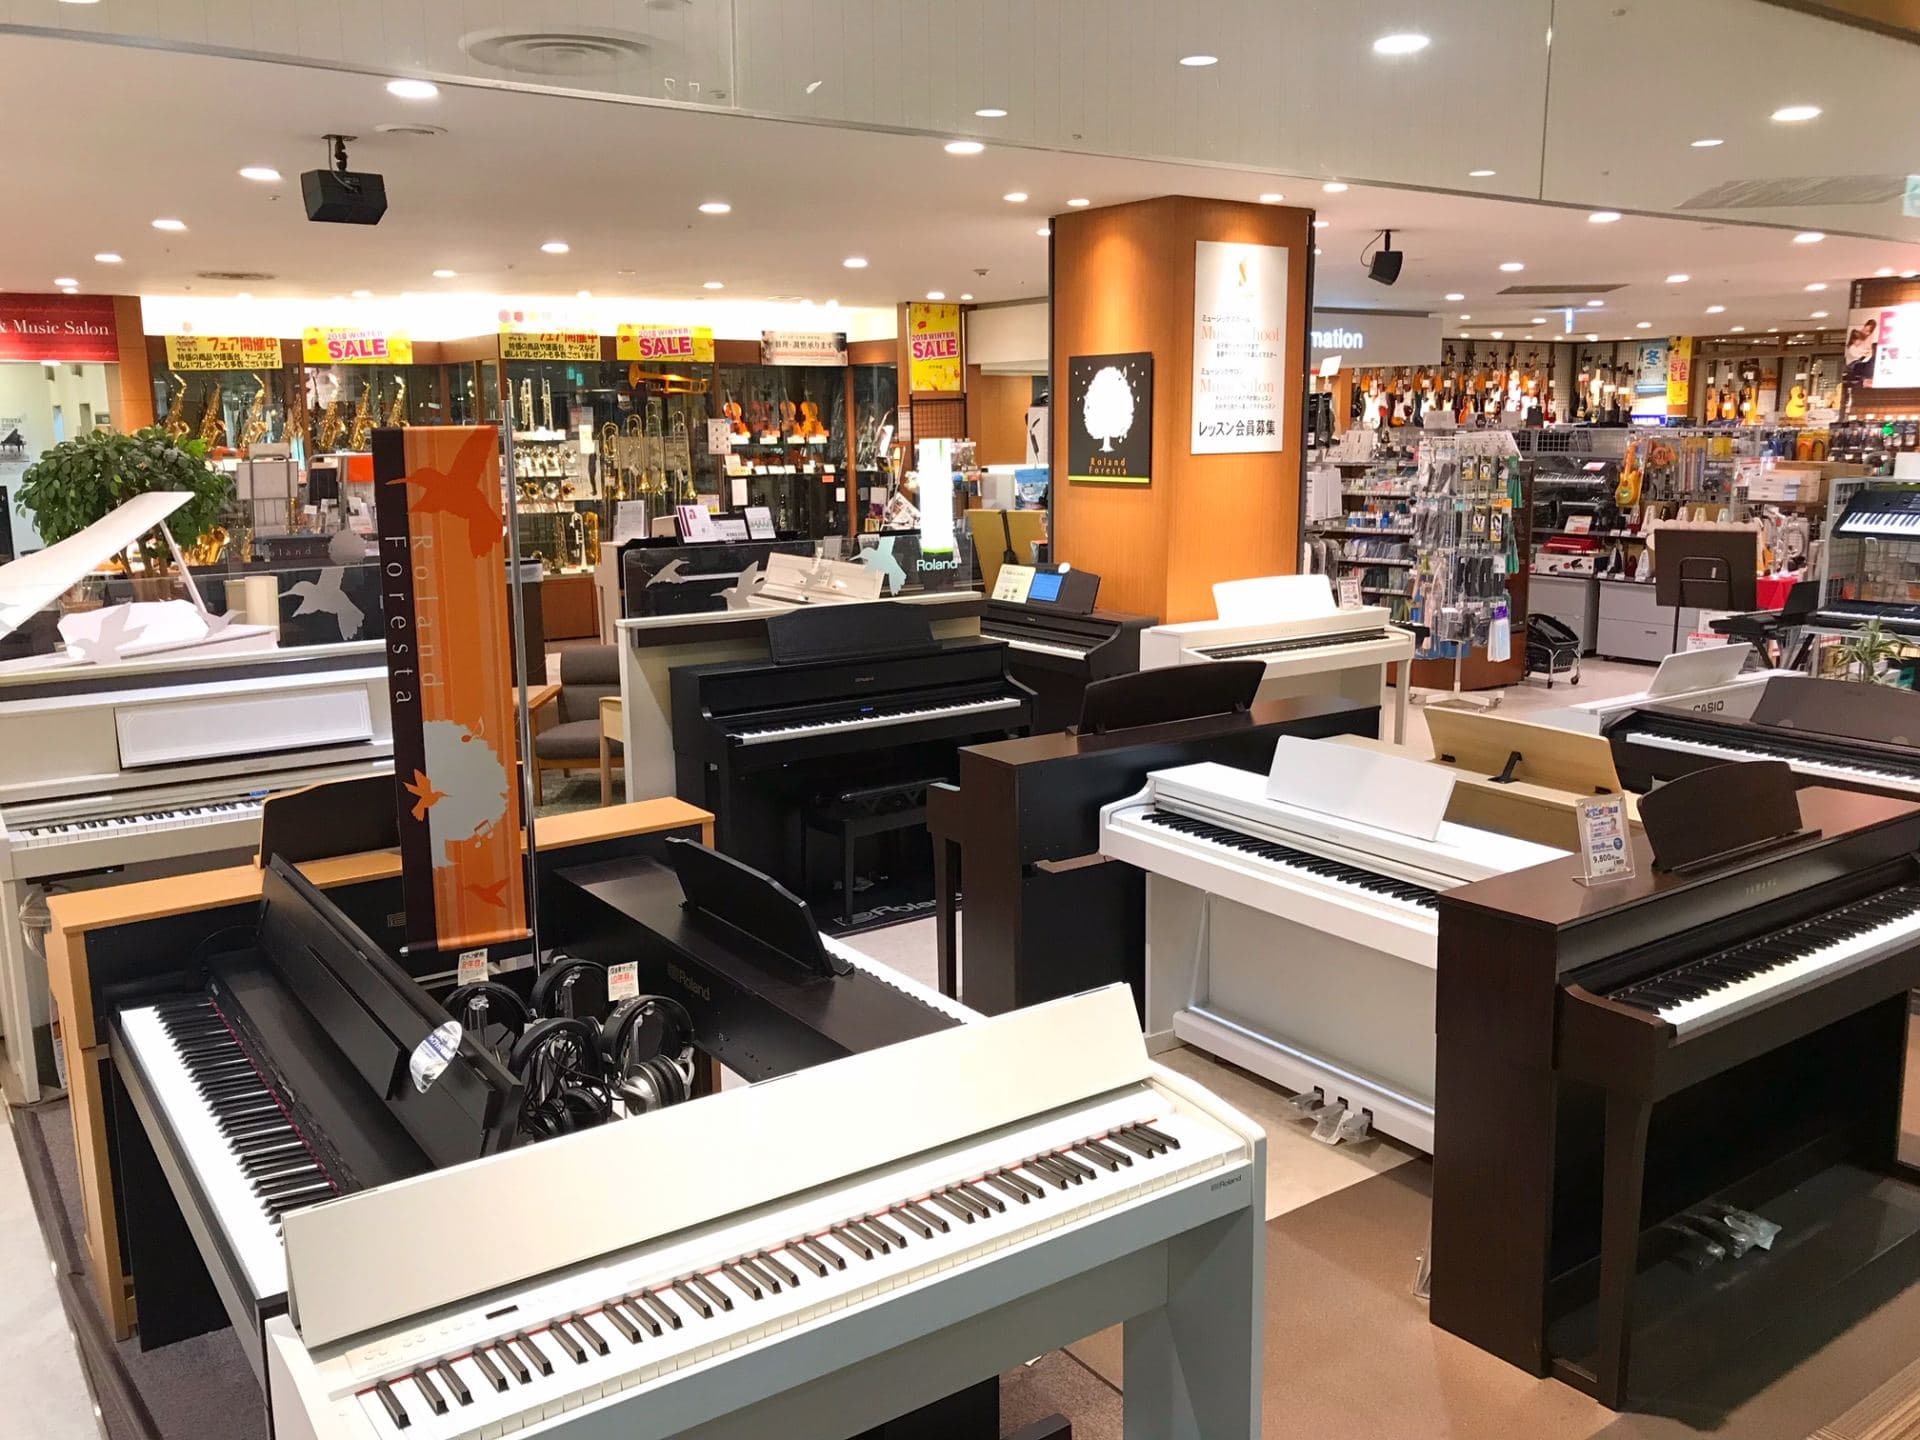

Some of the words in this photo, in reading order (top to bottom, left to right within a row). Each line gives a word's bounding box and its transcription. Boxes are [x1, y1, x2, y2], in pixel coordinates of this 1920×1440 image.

[13, 319, 60, 335] Music
[64, 320, 109, 336] Salon
[912, 333, 928, 341] 2018
[929, 331, 955, 340] WINTER
[327, 338, 387, 359] SALE
[639, 336, 692, 357] SALE
[912, 339, 957, 359] SALE
[1199, 420, 1276, 437] レッスン会員募集
[1089, 457, 1126, 467] Roland
[917, 558, 958, 572] Roland
[385, 536, 413, 703] Foresta
[411, 535, 444, 688] Roland
[1693, 700, 1724, 714] CASIO
[680, 971, 710, 1001] Roland
